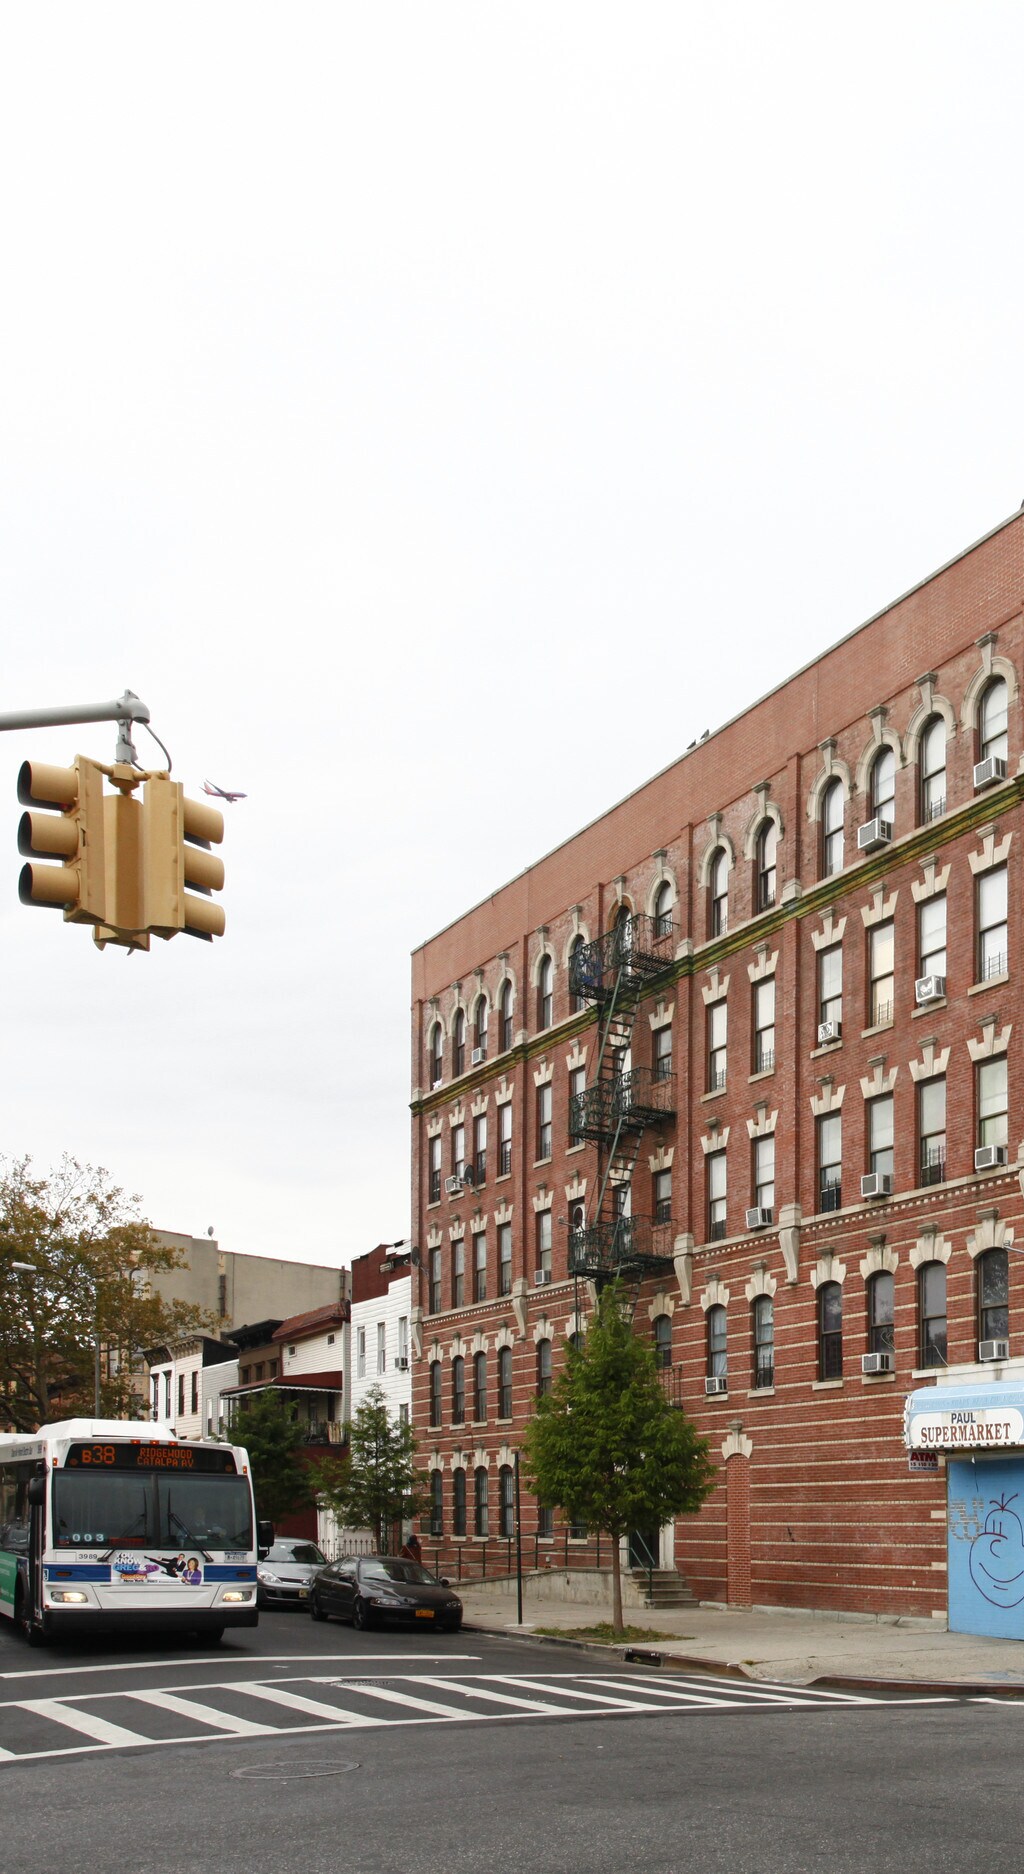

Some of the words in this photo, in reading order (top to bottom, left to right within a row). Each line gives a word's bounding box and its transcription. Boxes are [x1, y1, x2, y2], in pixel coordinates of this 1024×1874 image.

[951, 1412, 976, 1424] PAUL
[921, 1422, 1011, 1443] SUPERMARKET
[82, 1445, 116, 1464] B38
[139, 1448, 193, 1459] RIDGEWOOD
[910, 1452, 937, 1461] ATM
[137, 1456, 179, 1466] CATALPA
[181, 1459, 194, 1467] AV
